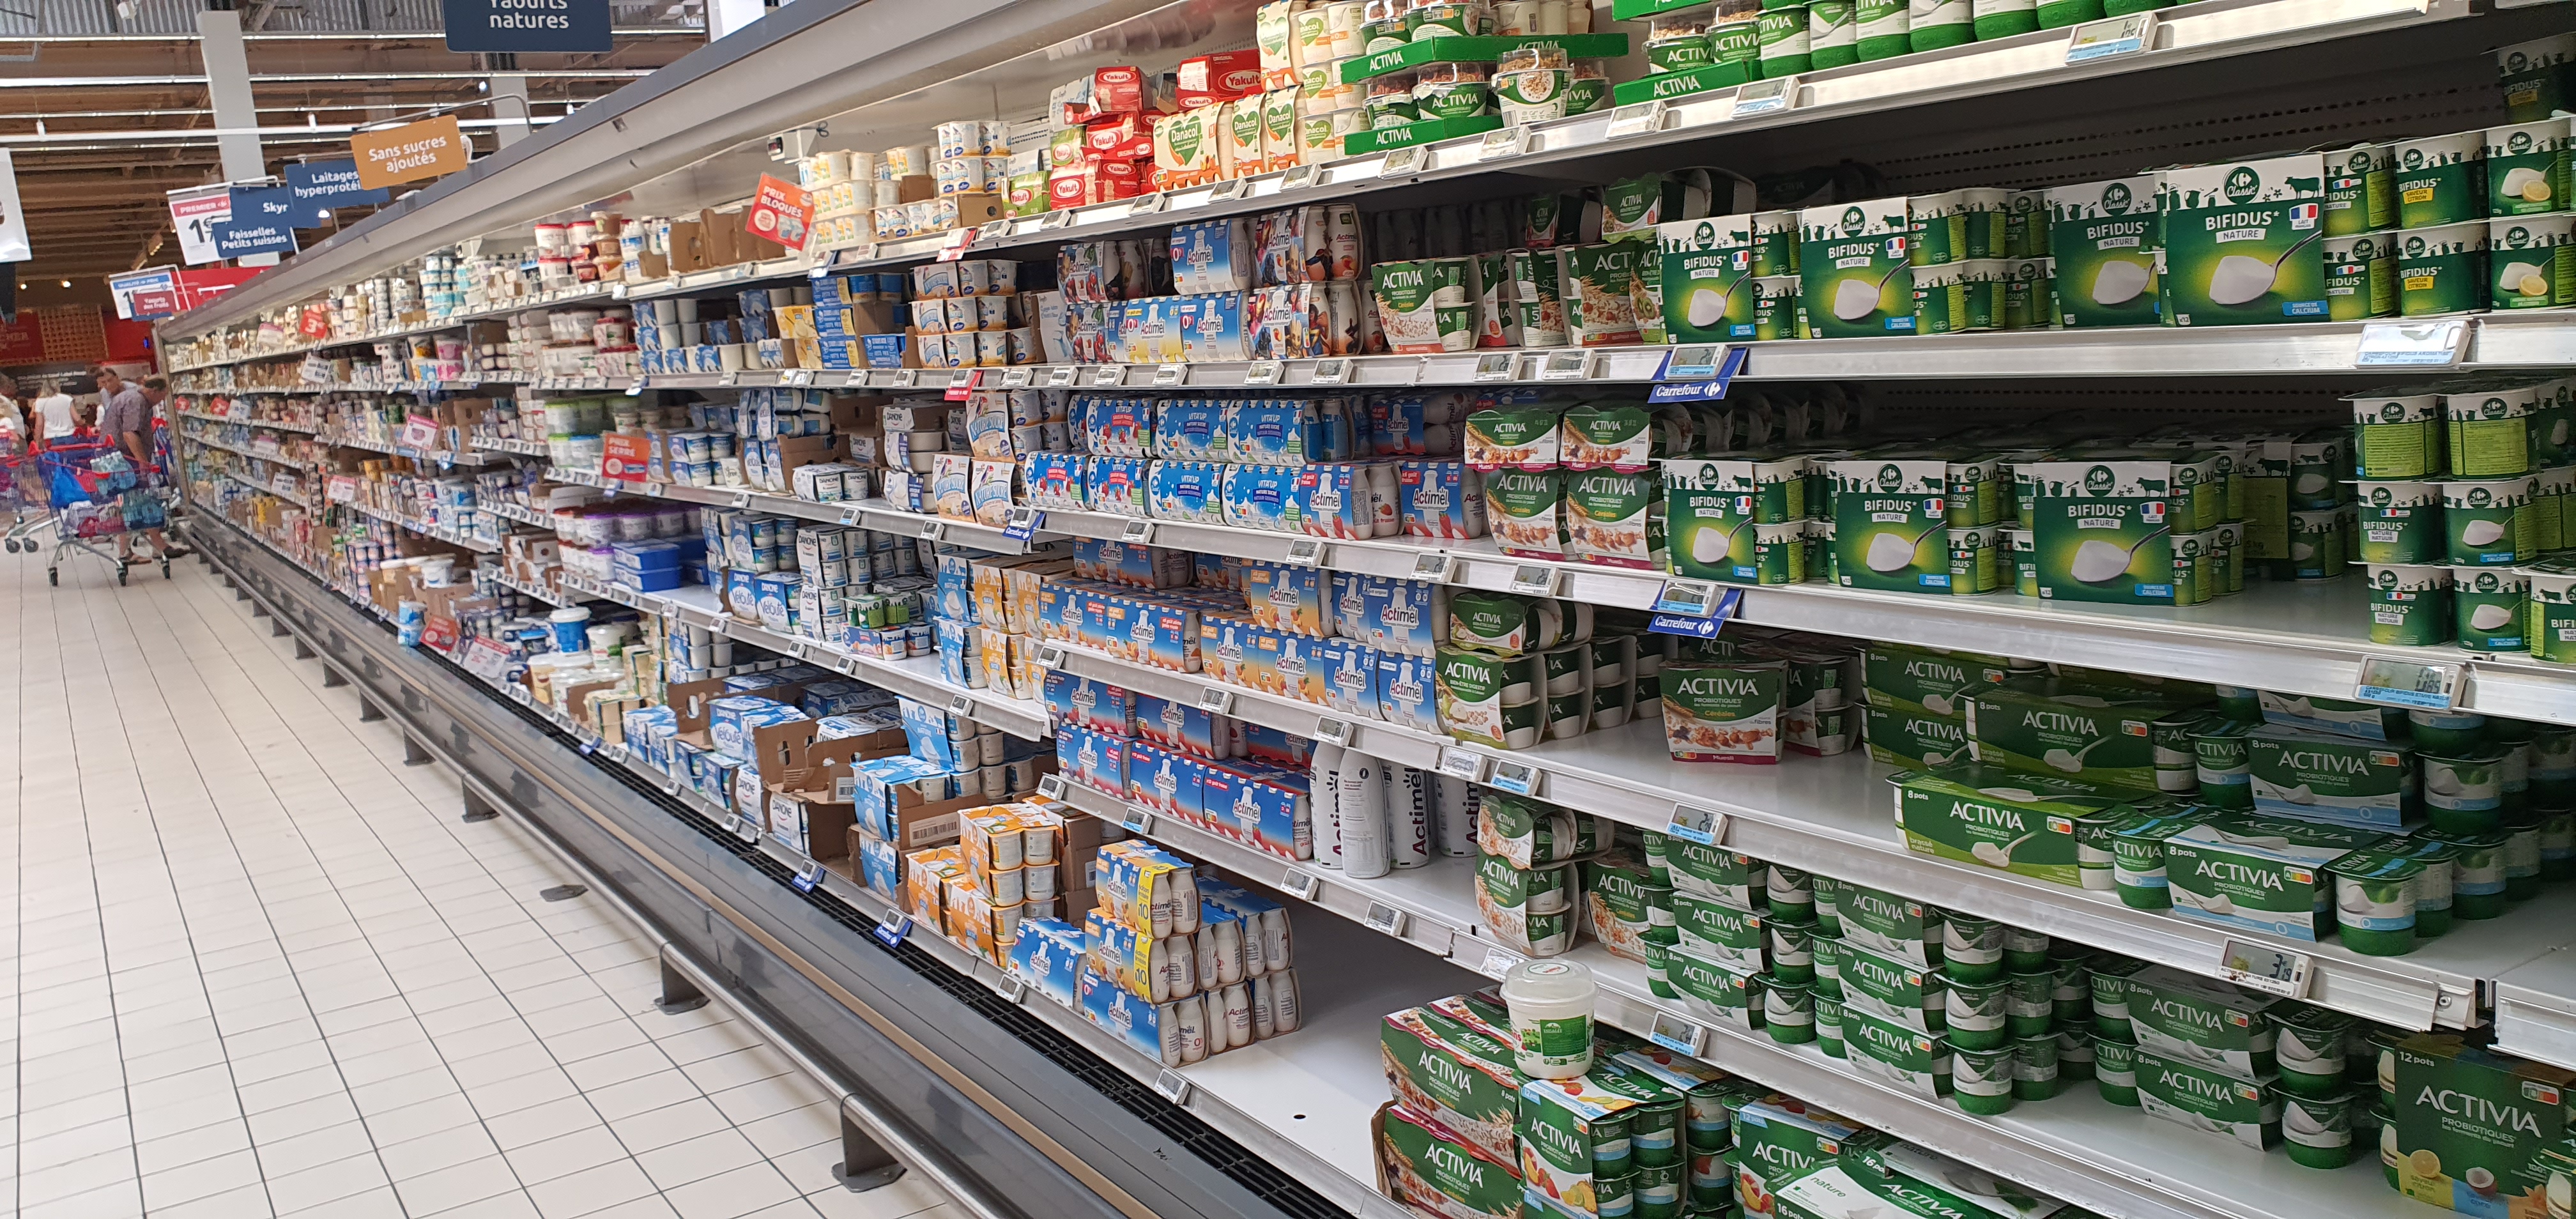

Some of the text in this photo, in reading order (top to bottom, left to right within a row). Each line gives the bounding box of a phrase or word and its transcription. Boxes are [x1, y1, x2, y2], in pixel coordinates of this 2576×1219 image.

[489, 12, 569, 29] natures
[1369, 52, 1404, 71] ACTIVIA
[1228, 71, 1261, 86] Yakult
[1653, 75, 1701, 97] ACTIVIA
[1432, 93, 1478, 109] ACTIVIA
[1235, 120, 1257, 129] Danacol
[1269, 114, 1291, 124] Danacol
[1092, 134, 1114, 147] Yakult
[1171, 127, 1199, 141] Danacol
[1376, 128, 1412, 144] ACTIVIA
[369, 136, 447, 162] Sans sucres
[387, 152, 436, 173] ajoutés
[312, 170, 358, 184] Laitages
[763, 185, 786, 202] PRIX
[1059, 184, 1077, 195] Yakult
[2227, 185, 2257, 197] Classic
[263, 202, 288, 215] Skyr
[760, 195, 803, 218] BLOQUÉS
[222, 234, 287, 249] Petits suisses
[229, 226, 276, 239] Faisselles
[2223, 229, 2258, 239] NATURE
[2104, 238, 2134, 247] NATURE
[1188, 250, 1213, 264] Actimel
[1841, 257, 1866, 266] NATURE
[1382, 270, 1422, 289] ACTIVIA
[1264, 306, 1292, 321] Actimel
[1140, 322, 1165, 335] Actimel
[1197, 318, 1223, 332] Actimel
[1656, 385, 1702, 397] Carrefour
[1387, 418, 1409, 431] Actimel
[1494, 423, 1526, 433] ACTIVIA
[1590, 420, 1621, 432] ACTIVIA
[1497, 475, 1547, 493] ACTIVIA
[1578, 477, 1636, 496] ACTIVIA
[1310, 491, 1340, 508] Actimel
[1413, 490, 1449, 507] Actimel
[2083, 519, 2117, 528] NATURE
[1099, 544, 1123, 559] Actimel
[1269, 587, 1300, 604] Actimel
[1340, 594, 1364, 614] Actimel
[1062, 606, 1082, 622] Actimel
[1381, 606, 1418, 624] Actimel
[1472, 612, 1501, 625] ACTIVIA
[1655, 615, 1697, 631] Carrefour
[1131, 623, 1154, 640] Actimel
[1216, 640, 1243, 659] Actimel
[1276, 654, 1306, 673] Actimel
[1905, 661, 1965, 683] ACTIVIA
[1334, 667, 1365, 687] Actimel
[1445, 661, 1491, 685] ACTIVIA
[1390, 678, 1422, 698] Actimel
[1677, 678, 1759, 696] ACTIVIA
[1071, 688, 1096, 705] Actimel
[1161, 705, 1184, 723] Actimel
[2022, 710, 2098, 736] ACTIVIA
[1905, 719, 1964, 742] ACTIVIA
[2252, 739, 2259, 749] 8
[1078, 747, 1098, 765] Actimel
[2278, 749, 2370, 776] ACTIVIA
[1153, 771, 1176, 790] Actimel
[2296, 772, 2350, 783] PROBIOTIQUES
[1233, 799, 1261, 818] Actimel
[1950, 801, 2025, 831] ACTIVIA
[1496, 812, 1515, 829] ACTIVIA
[1682, 845, 1731, 870] ACTIVIA
[2170, 847, 2197, 858] 8 pots
[1482, 858, 1519, 889] ACTIVIA
[2195, 860, 2284, 891] ACTIVIA
[1107, 880, 1128, 900] Actimel
[2214, 882, 2266, 896] PROBIOTIQUES
[1853, 894, 1905, 923] ACTIVIA
[1692, 908, 1743, 933] ACTIVIA
[1098, 944, 1122, 963] Actimel
[1030, 954, 1050, 974] Actimel
[1682, 964, 1730, 992] ACTIVIA
[1852, 958, 1905, 990] ACTIVIA
[1108, 1004, 1132, 1027] Actimel
[2150, 997, 2224, 1032] ACTIVIA
[1457, 1032, 1504, 1054] ACTIVIA
[1859, 1023, 1913, 1056] ACTIVIA
[2138, 1054, 2145, 1064] 8
[2400, 1051, 2435, 1067] 12 pots
[1418, 1050, 1472, 1094] ACTIVIA
[1429, 1076, 1461, 1098] PROBIOTIQUES
[1597, 1072, 1657, 1099] ACTIVIA
[2158, 1070, 2234, 1105] ACTIVIA
[2416, 1085, 2542, 1138] ACTIVIA
[1531, 1116, 1584, 1159] ACTIVIA
[2442, 1117, 2517, 1142] PROBIOTIQUES
[1424, 1142, 1483, 1189] ACTIVIA
[1862, 1155, 1874, 1165] 16
[1436, 1168, 1471, 1191] PROBIOTIQUES
[1809, 1176, 1846, 1198] nature
[1777, 1203, 1788, 1216] 16
